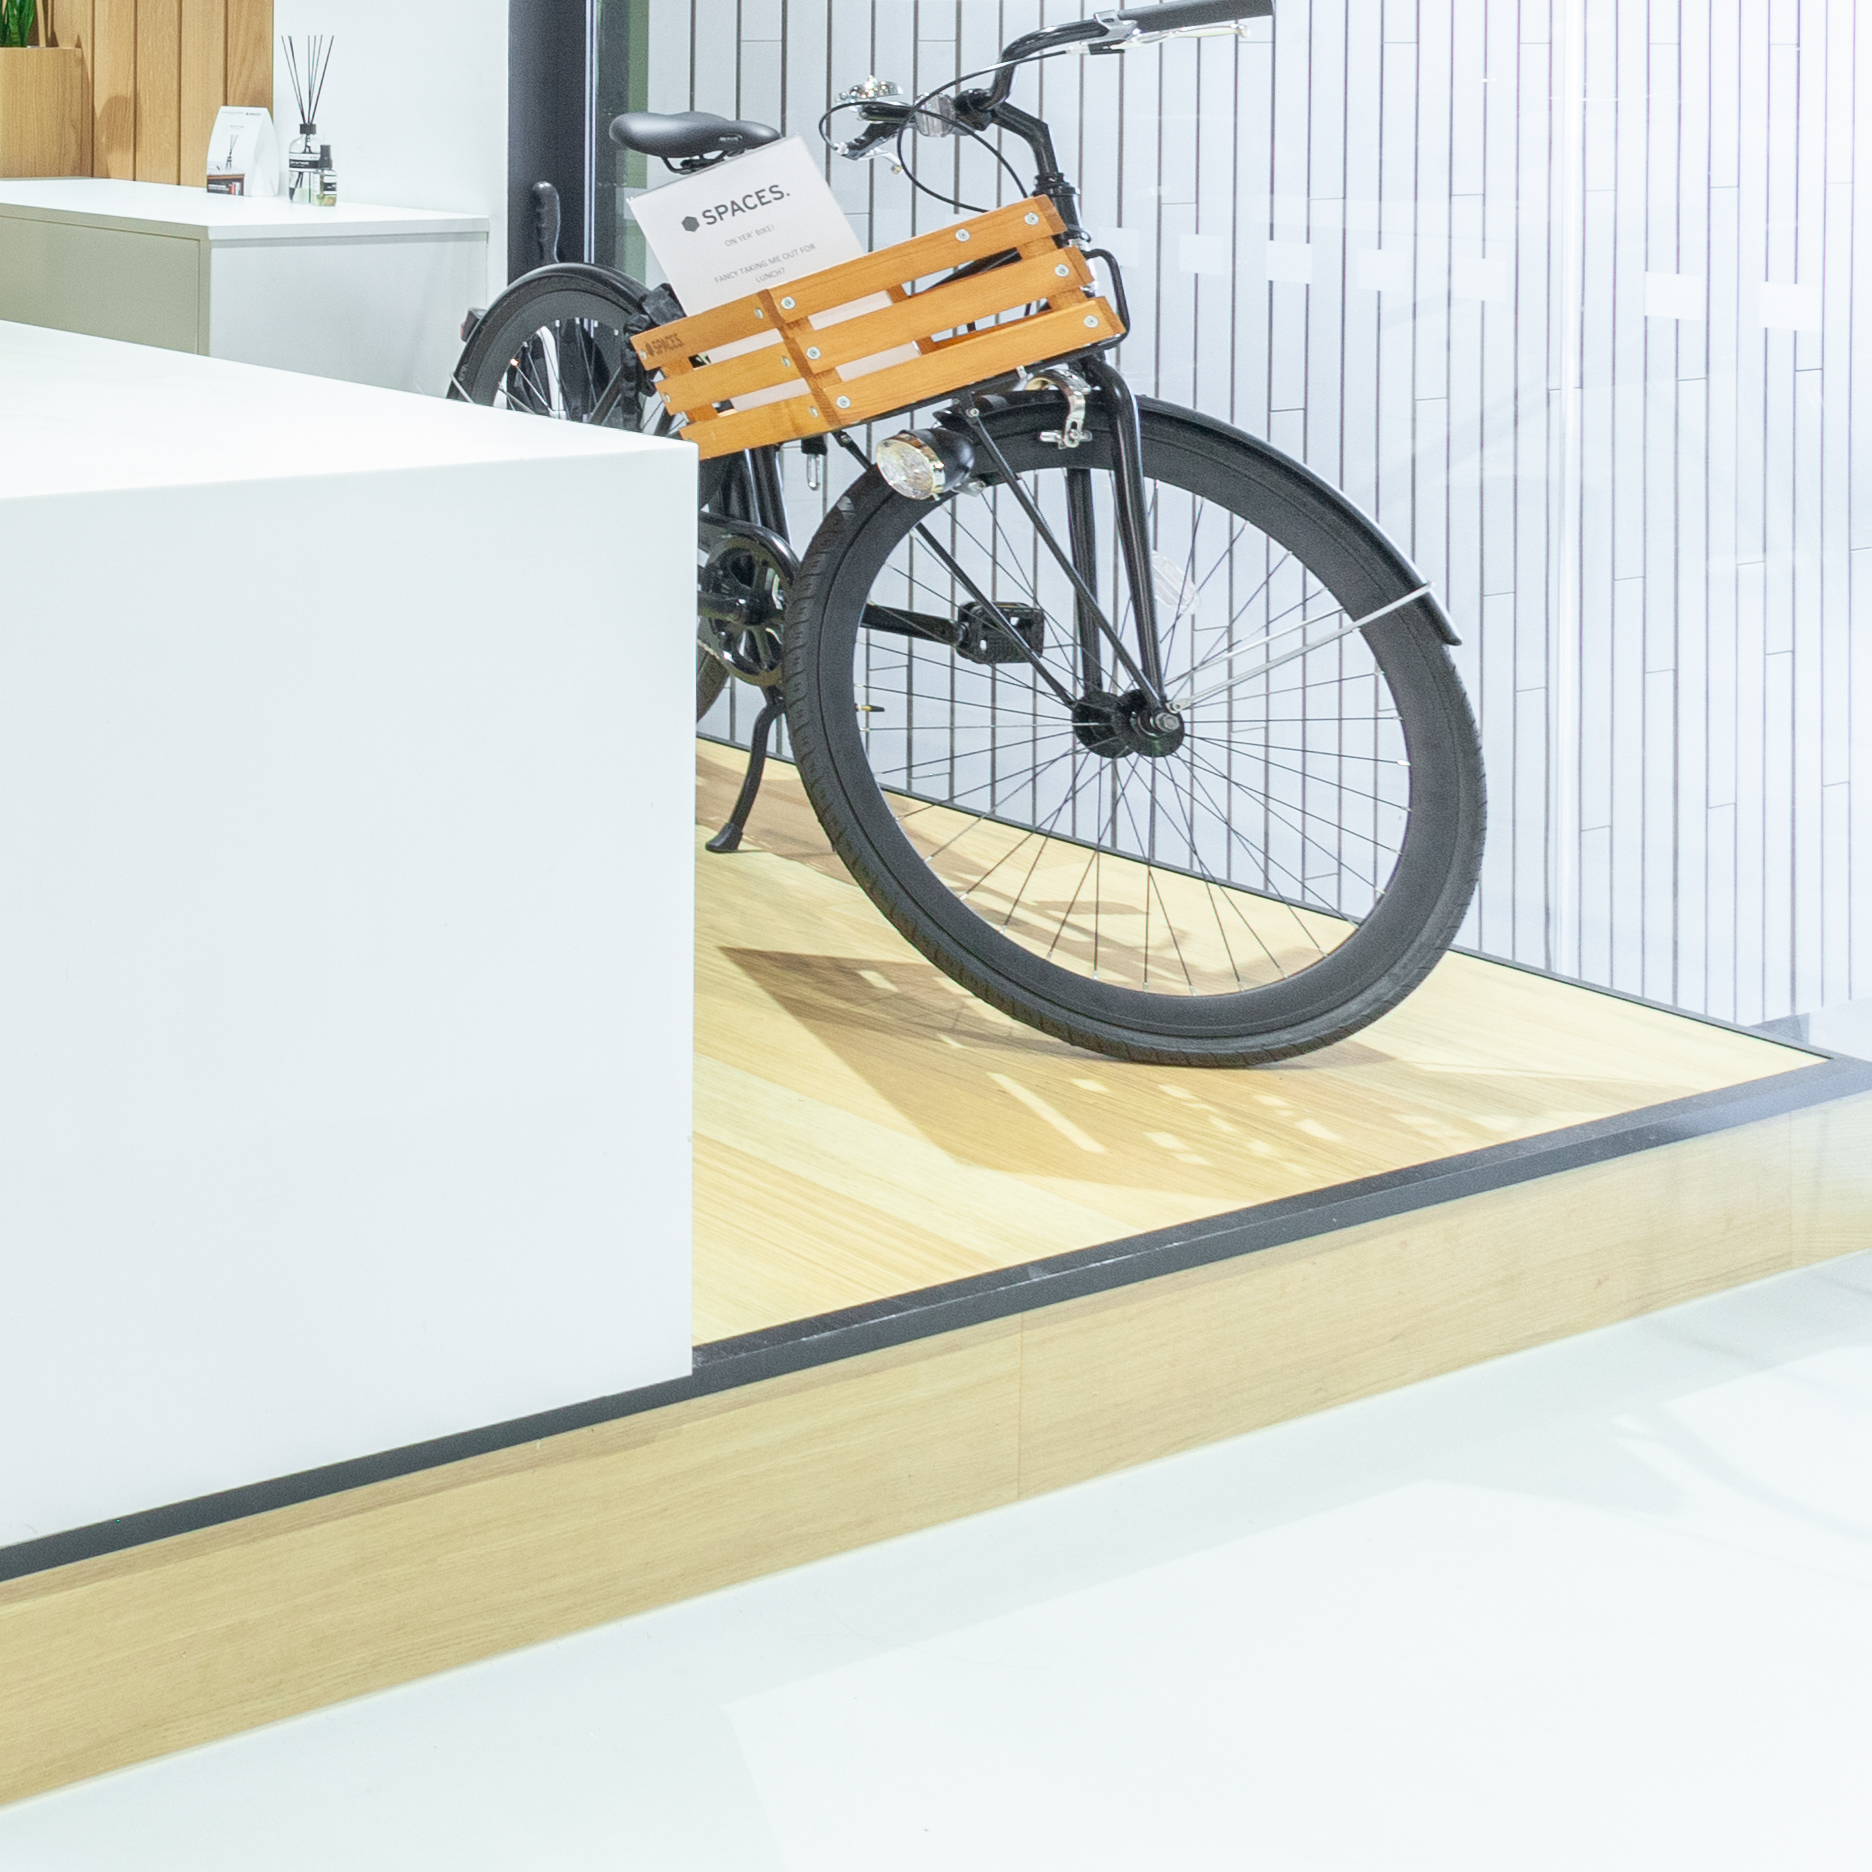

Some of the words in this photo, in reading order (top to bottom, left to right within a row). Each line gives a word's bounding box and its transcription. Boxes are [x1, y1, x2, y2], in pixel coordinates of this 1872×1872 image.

[701, 184, 791, 225] SPACES.
[724, 237, 738, 247] ON
[714, 270, 739, 284] FANCY
[739, 259, 769, 276] TAKING
[768, 255, 782, 266] ME
[782, 249, 800, 261] OUT
[799, 243, 817, 255] FOR
[755, 267, 786, 283] LUNCH?
